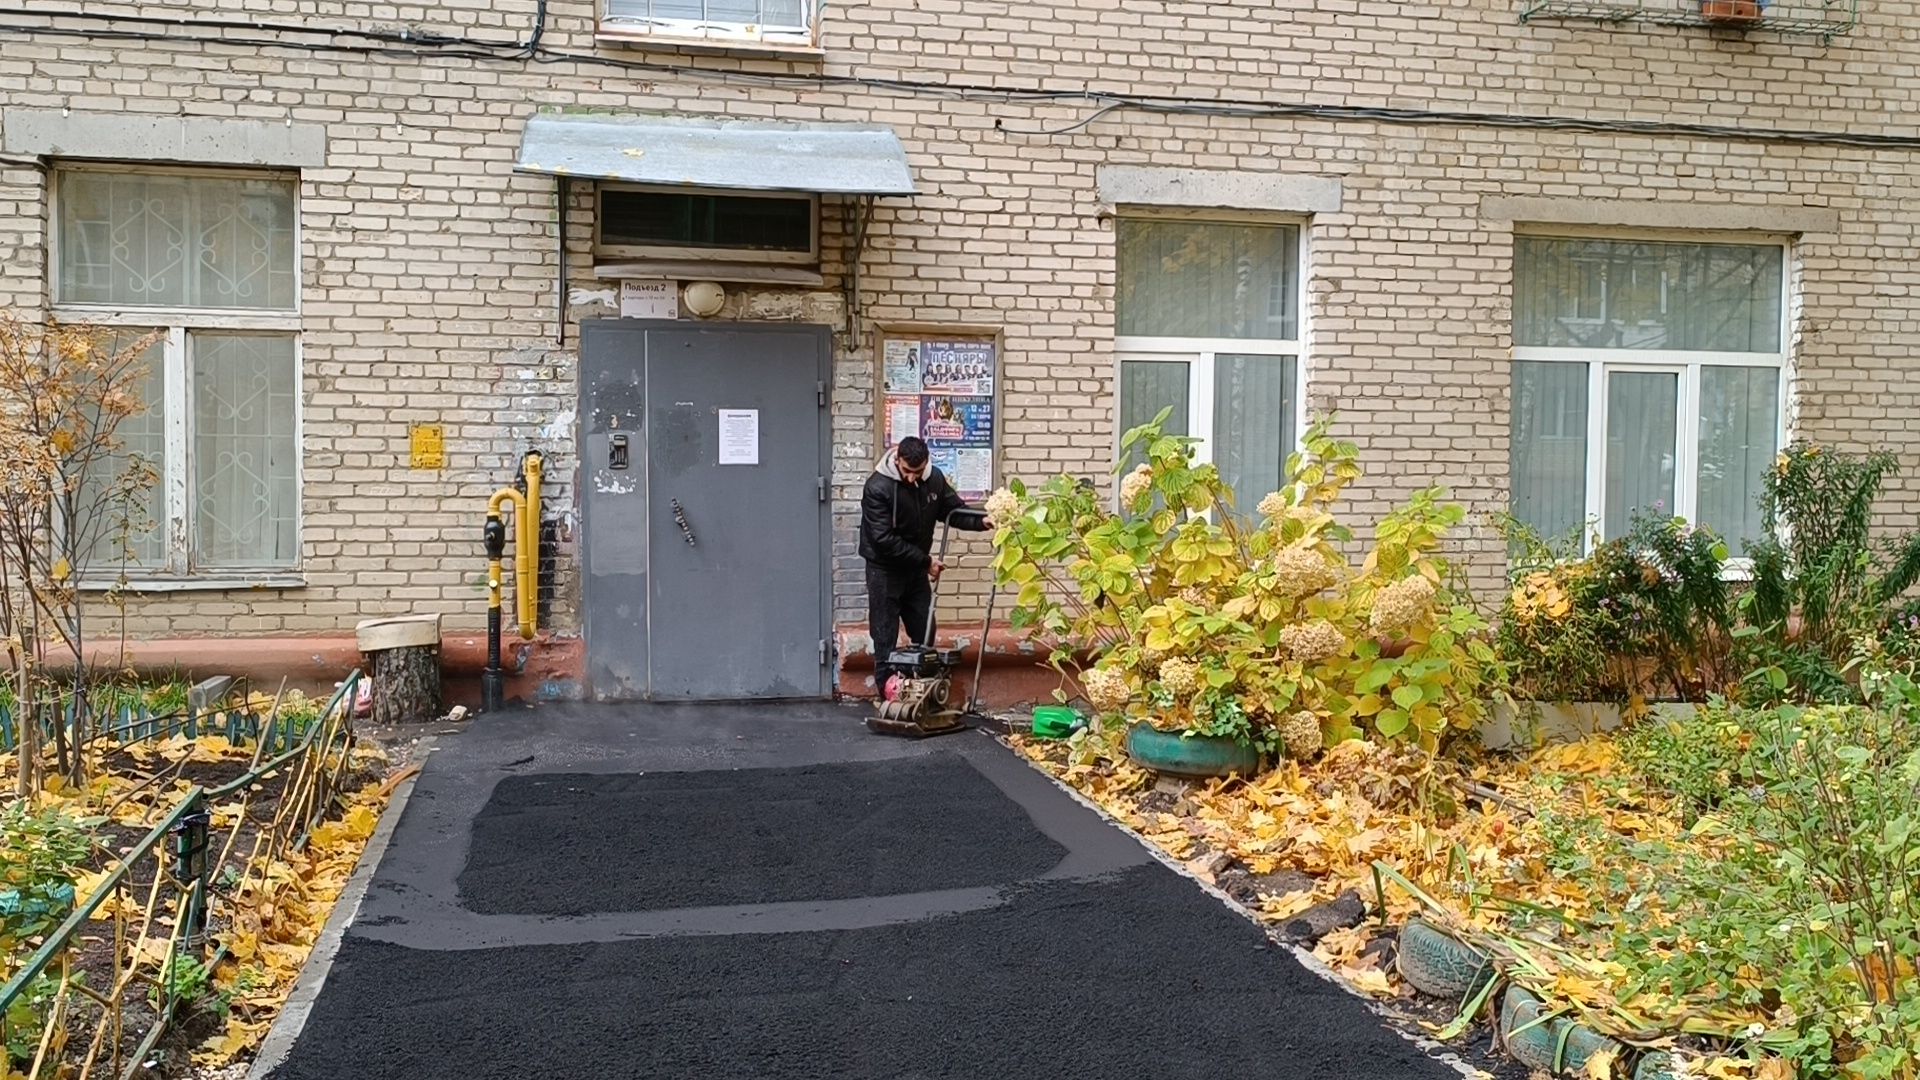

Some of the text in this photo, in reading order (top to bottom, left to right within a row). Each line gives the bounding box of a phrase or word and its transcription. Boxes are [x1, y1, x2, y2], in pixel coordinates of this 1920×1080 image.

[625, 283, 666, 292] Подъезд 2
[932, 351, 986, 364] ПЕСНЯРЫ
